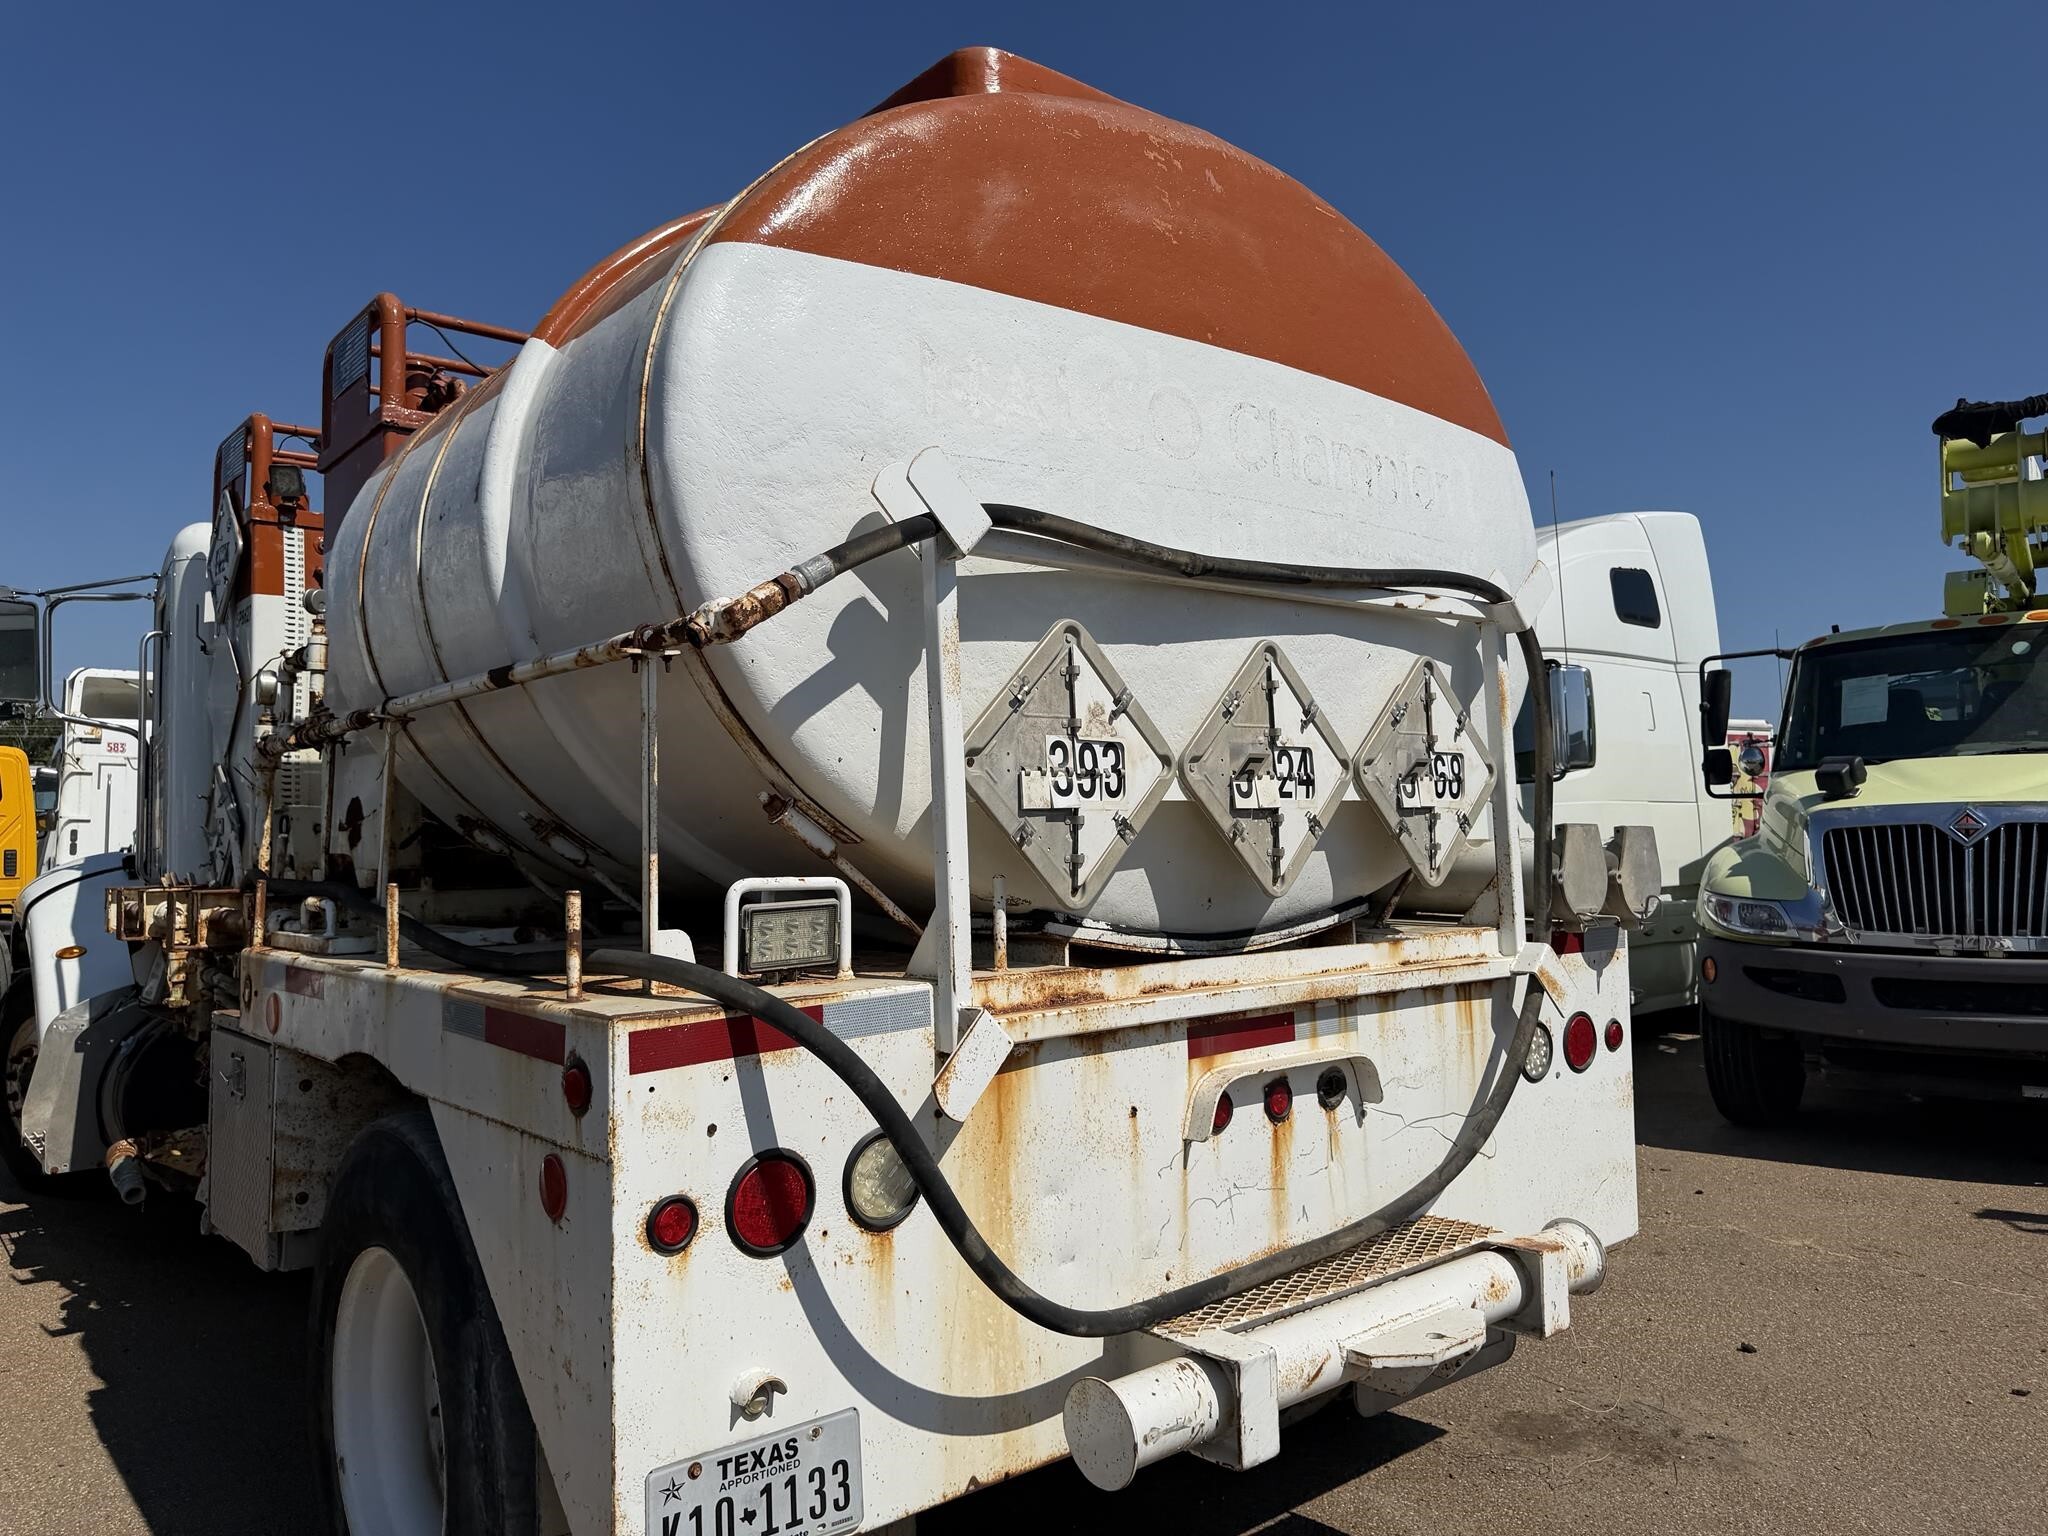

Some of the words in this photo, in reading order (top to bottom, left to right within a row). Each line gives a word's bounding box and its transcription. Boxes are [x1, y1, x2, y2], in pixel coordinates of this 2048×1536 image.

[107, 742, 127, 754] 583
[1049, 740, 1123, 799] 393
[1277, 748, 1314, 799] 24
[1434, 754, 1462, 800] 68
[717, 1437, 799, 1481] TEXAS
[719, 1458, 801, 1493] APPORTIONED
[760, 1459, 850, 1536] 1133
